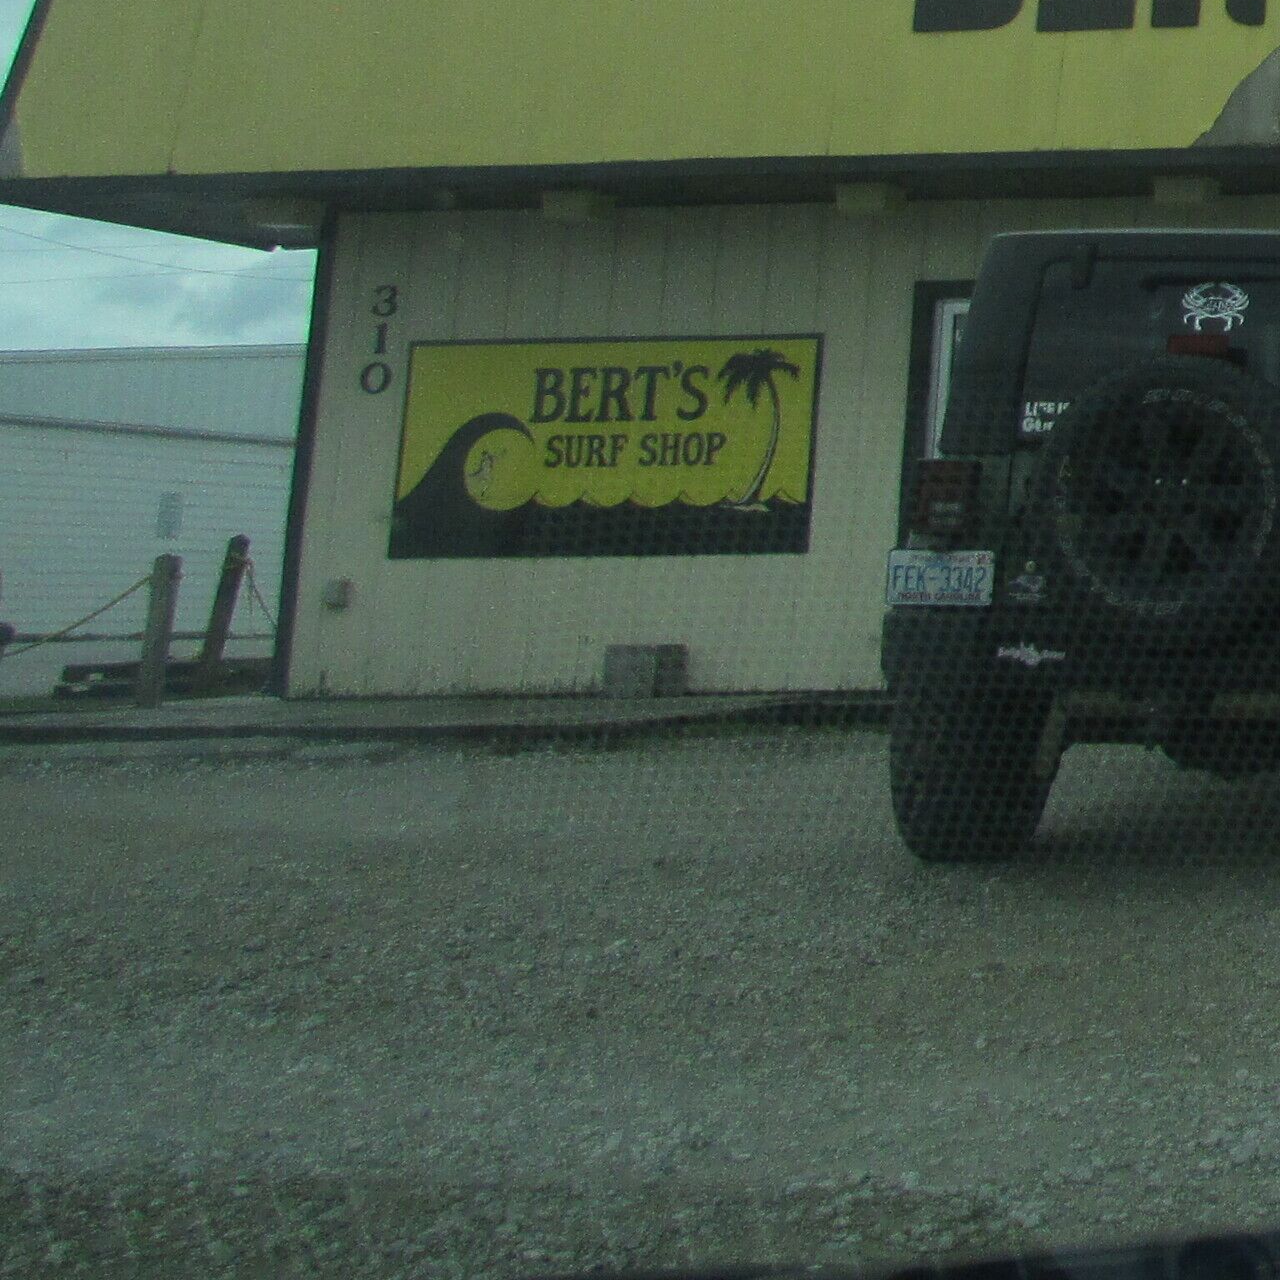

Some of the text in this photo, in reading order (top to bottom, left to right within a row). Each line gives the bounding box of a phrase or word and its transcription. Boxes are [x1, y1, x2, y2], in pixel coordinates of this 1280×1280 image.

[361, 284, 398, 395] 310
[530, 360, 711, 424] BERT'S
[544, 431, 727, 469] SURF SHOP
[893, 564, 987, 592] FEK-3342
